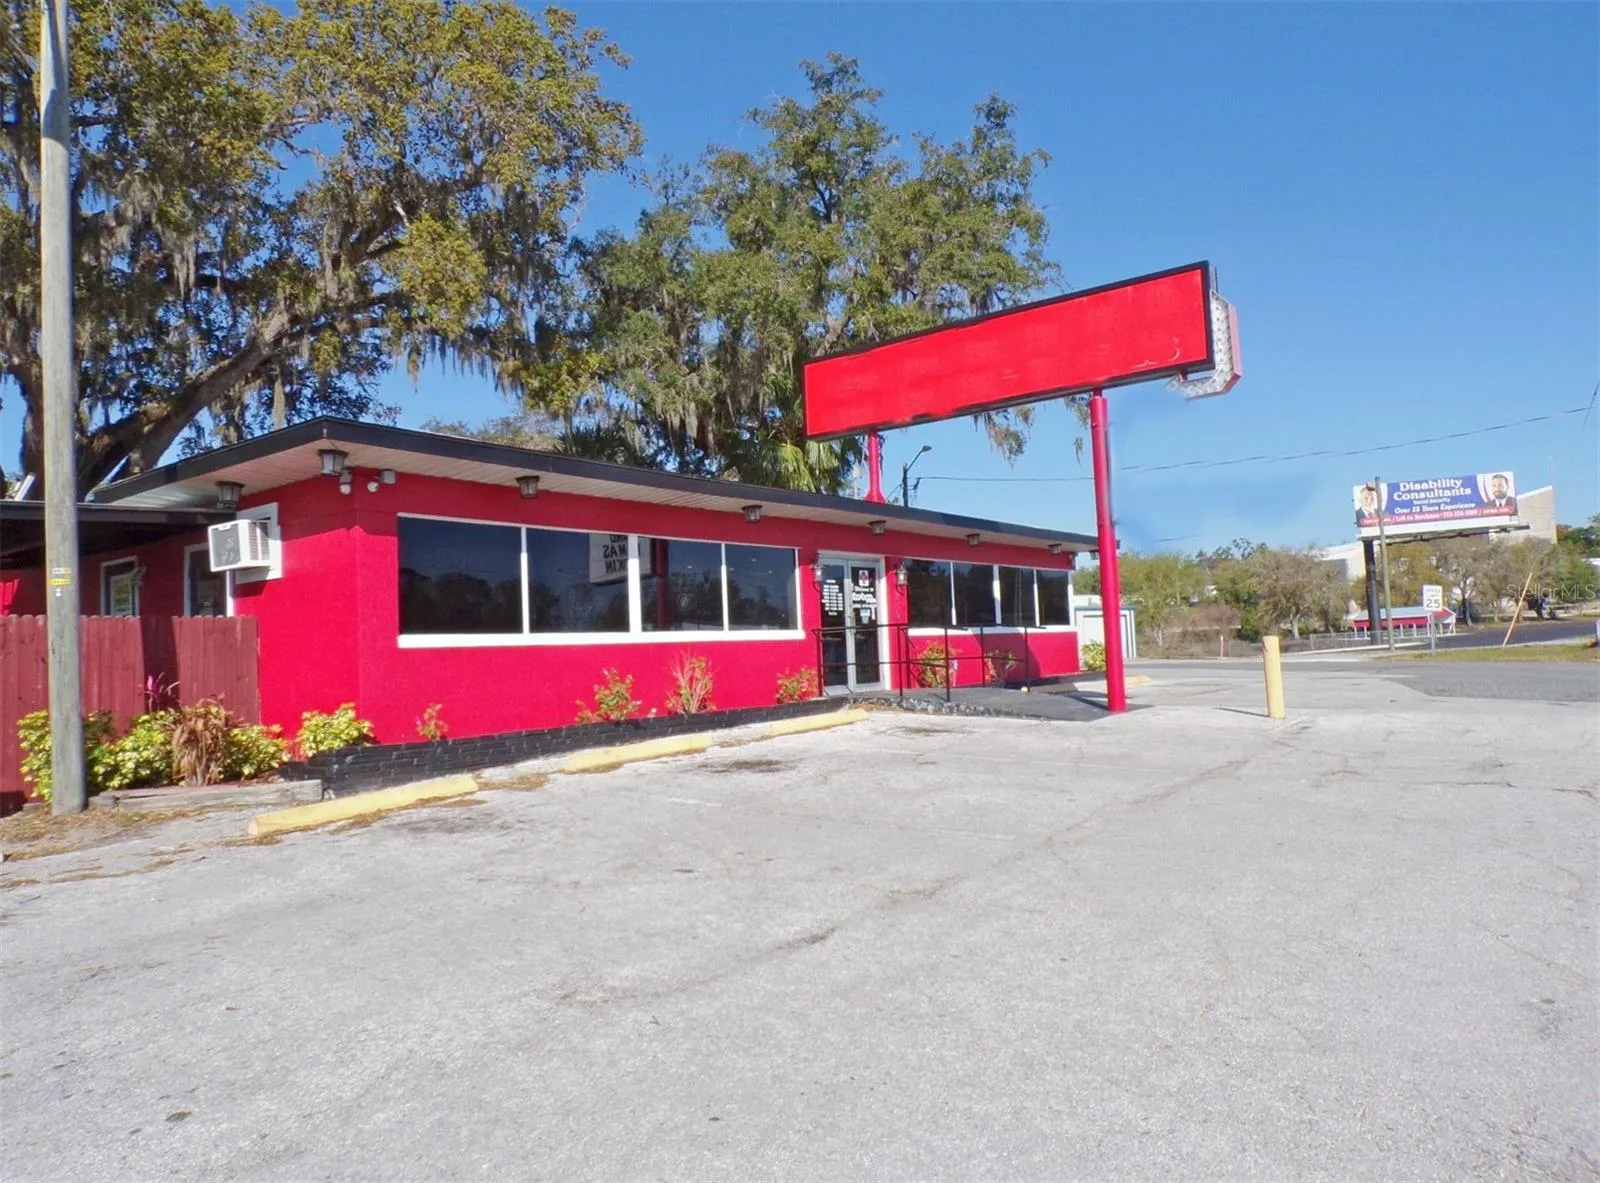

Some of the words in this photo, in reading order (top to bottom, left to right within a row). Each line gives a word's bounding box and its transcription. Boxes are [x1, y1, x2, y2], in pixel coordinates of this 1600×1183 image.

[1400, 479, 1463, 491] Disability
[1393, 487, 1472, 501] Consultants
[1394, 506, 1411, 514] Over
[1440, 502, 1476, 511] Experience
[1426, 598, 1441, 608] 25
